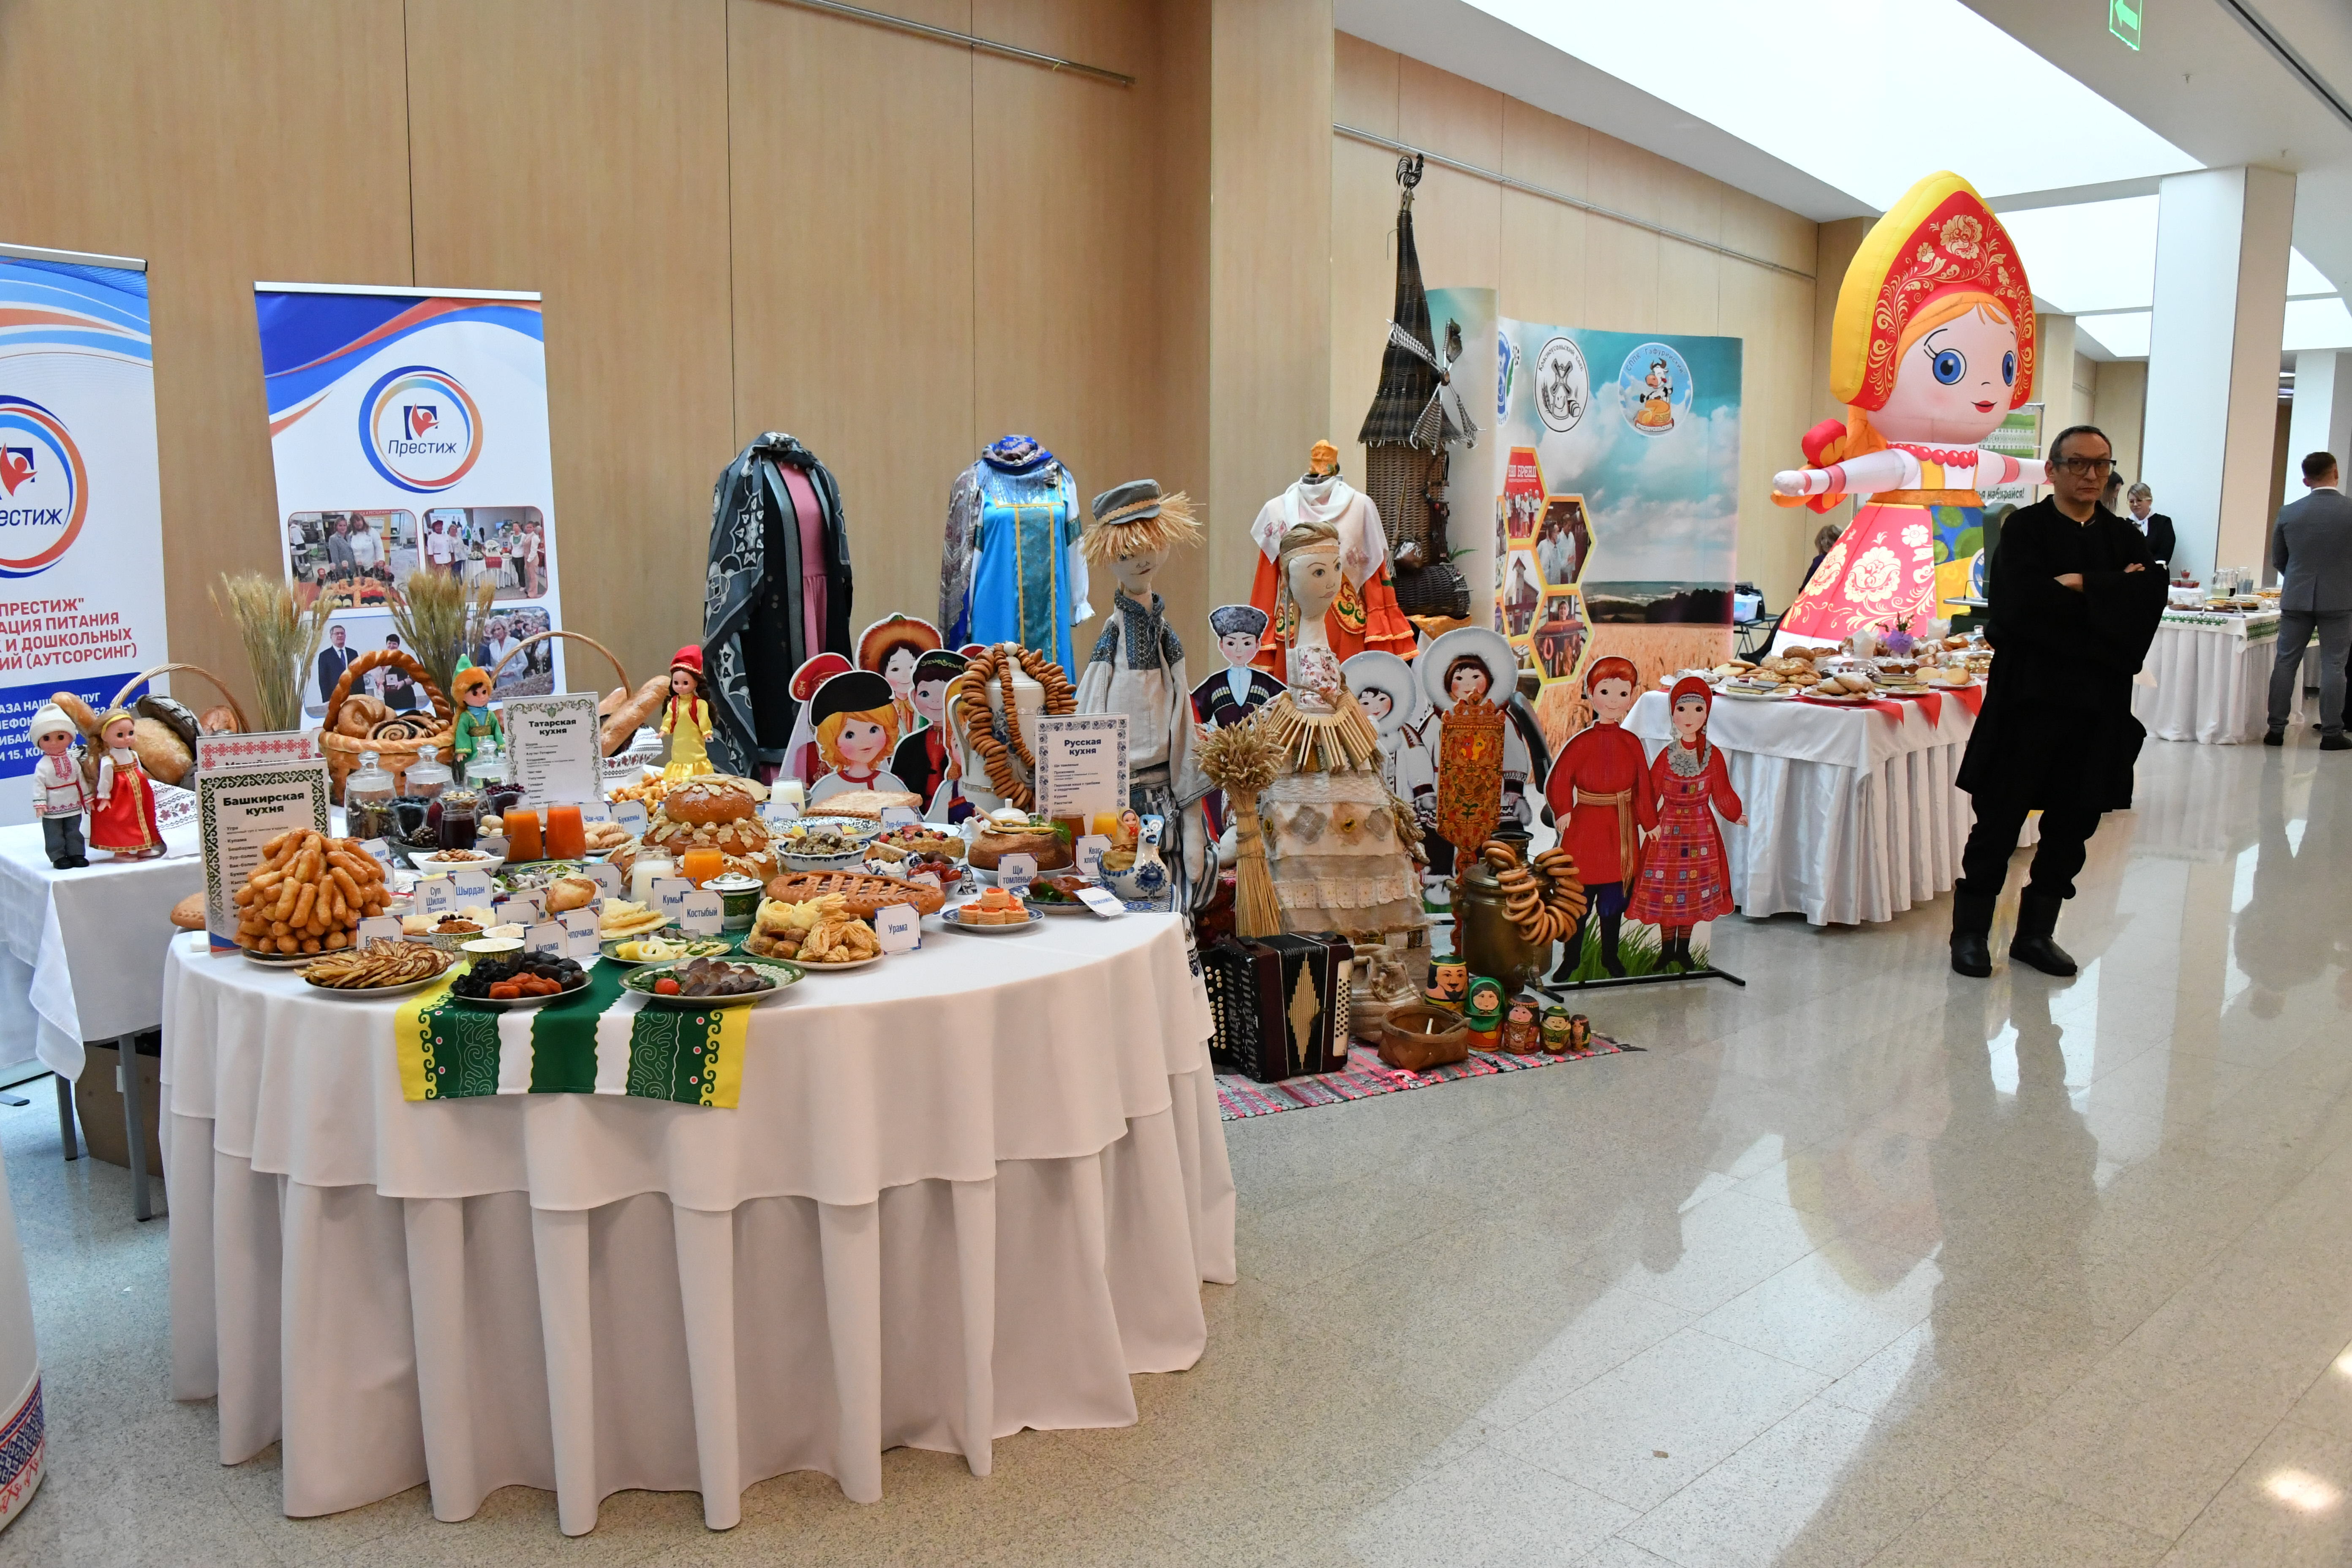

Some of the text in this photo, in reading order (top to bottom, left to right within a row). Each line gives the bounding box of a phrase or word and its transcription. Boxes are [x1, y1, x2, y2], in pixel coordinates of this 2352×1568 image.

[388, 440, 457, 457] Престиж
[1987, 487, 2025, 501] набирайся!
[46, 612, 119, 631] ПИТАНИЯ
[5, 627, 133, 653] И ДОШКОЛЬНЫХ
[26, 642, 137, 670] (АУТСОРСИНГ)
[528, 719, 577, 728] Татарская
[539, 728, 567, 736] кухня
[1064, 739, 1102, 748] Русская
[7, 749, 23, 760] 15,
[1069, 748, 1097, 757] кухня
[223, 792, 305, 806] Башкирская
[246, 805, 284, 817] кухня
[618, 814, 640, 824] Буккены
[1013, 865, 1023, 876] Щи
[430, 887, 441, 897] Суп
[456, 886, 485, 897] Шырдан
[426, 896, 446, 906] Шилан
[663, 895, 680, 906] Кумы
[687, 907, 718, 918] Костыбый
[888, 923, 908, 935] Урама
[536, 942, 559, 952] Кулама
